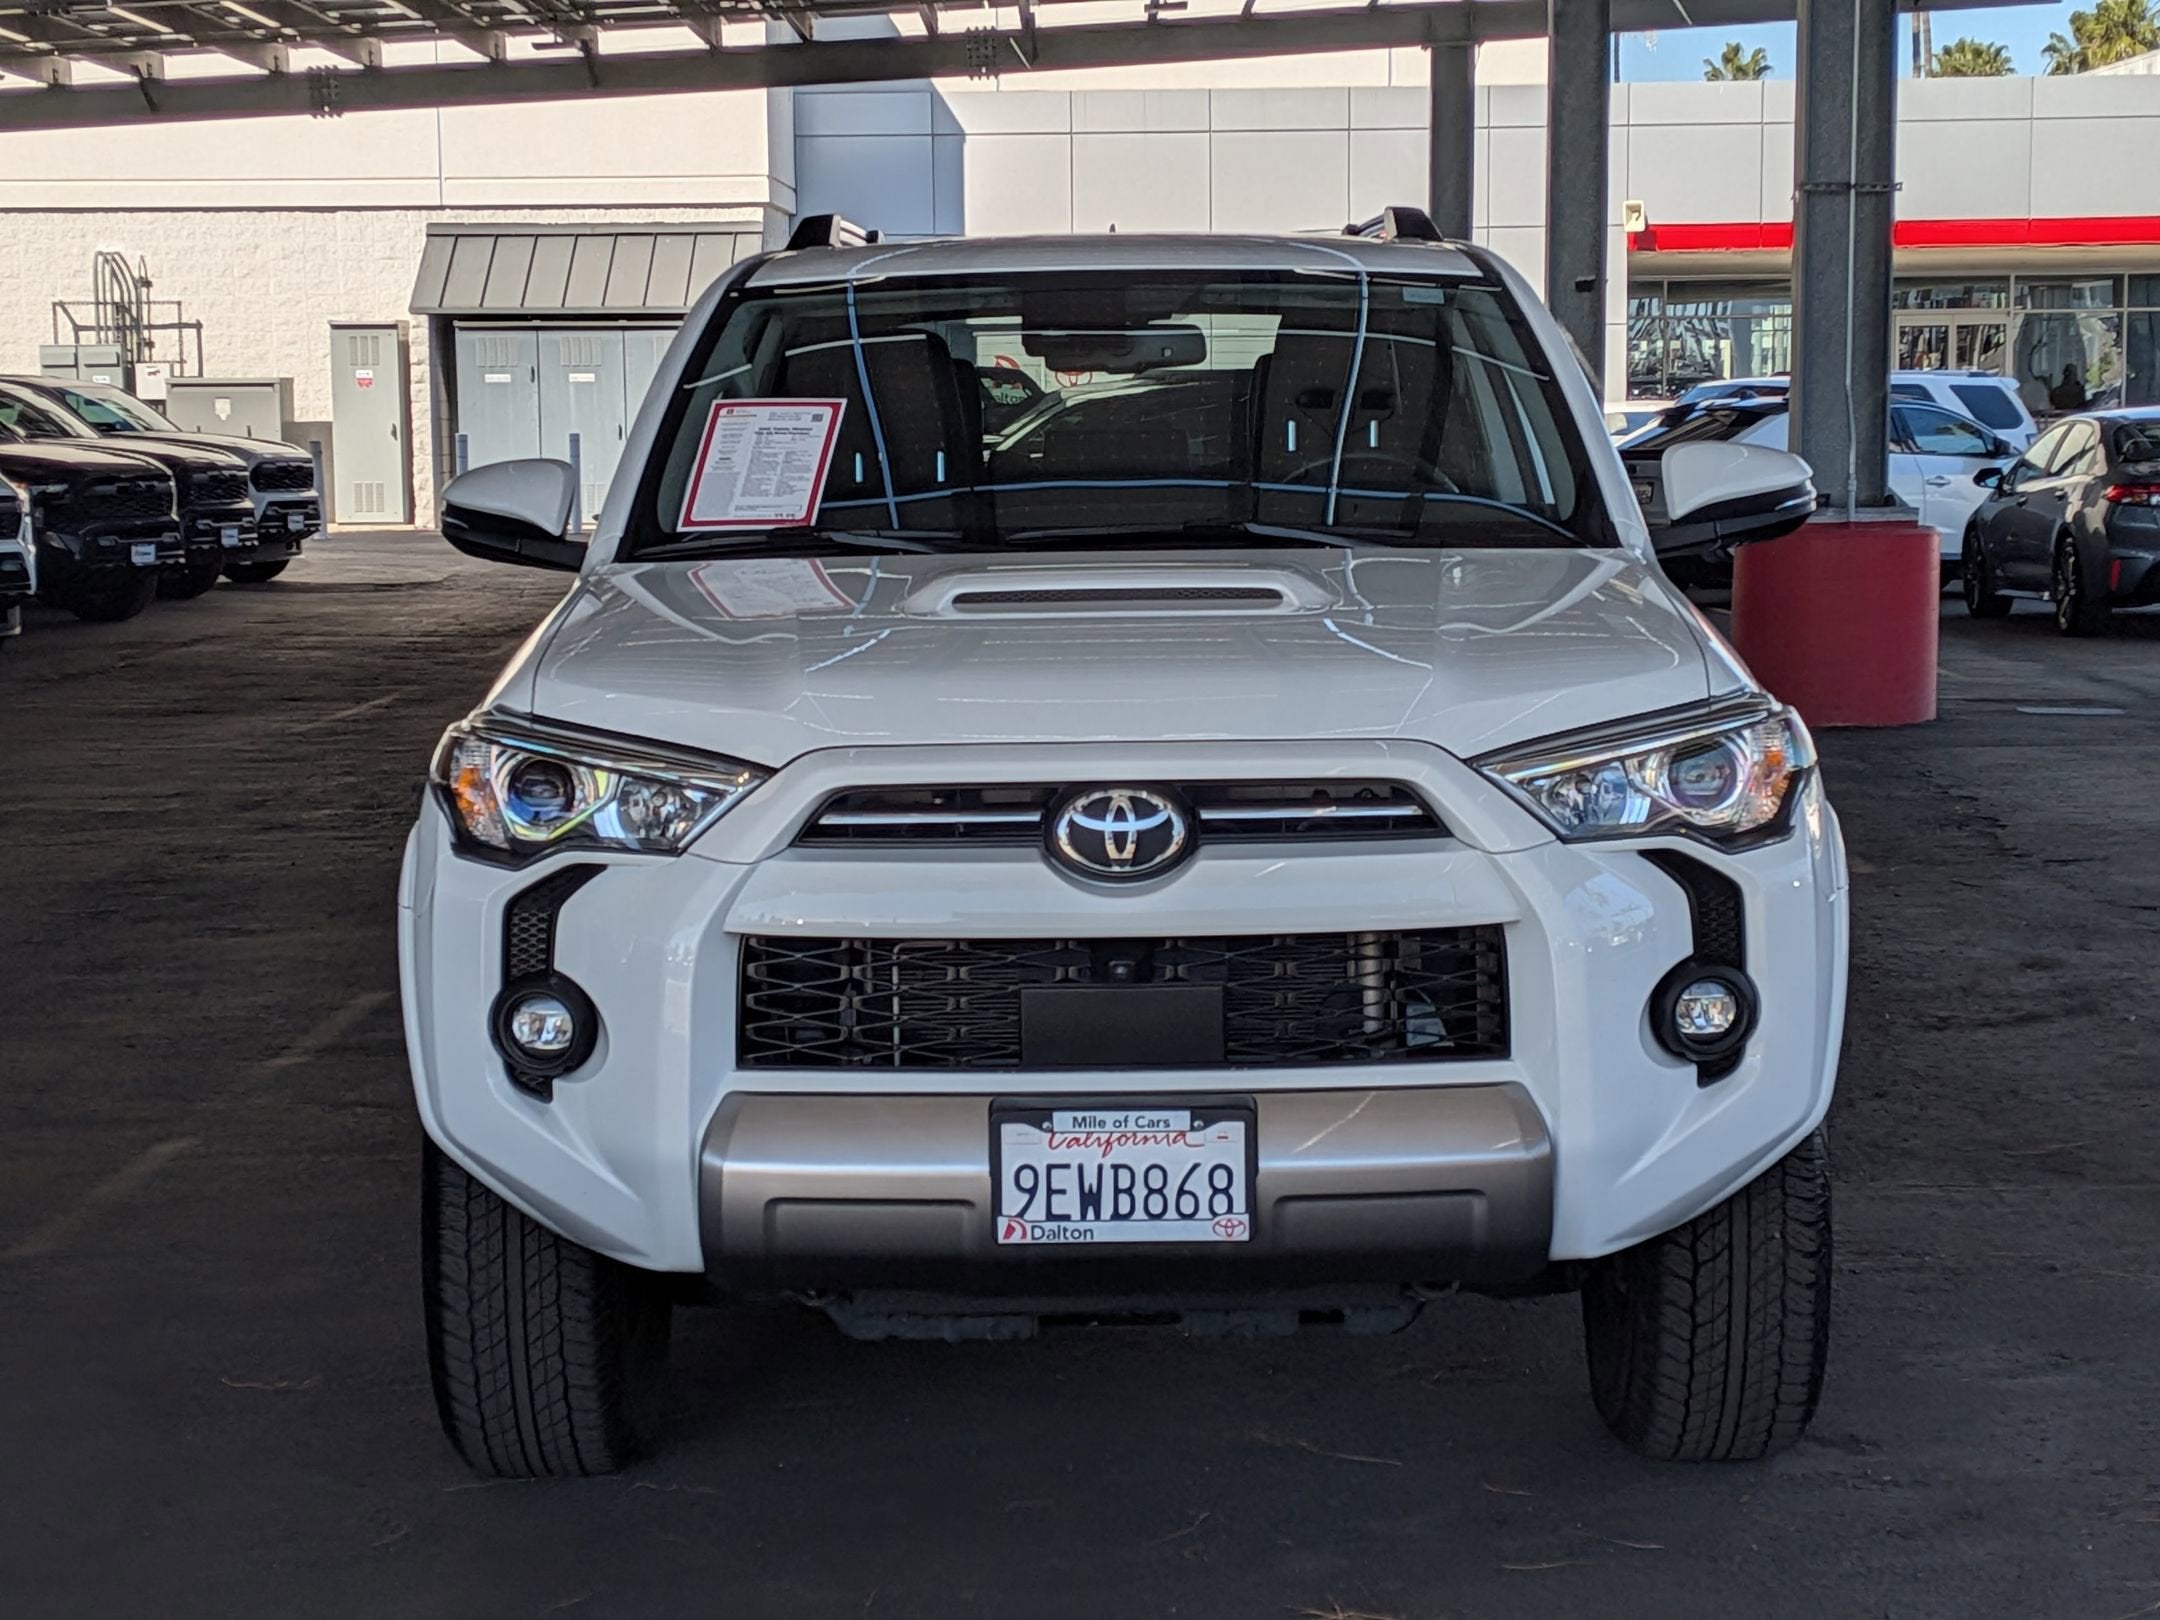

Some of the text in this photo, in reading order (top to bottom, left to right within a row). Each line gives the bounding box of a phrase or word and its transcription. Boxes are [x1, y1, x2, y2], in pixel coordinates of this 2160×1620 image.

[1072, 1115, 1172, 1129] Mile of Cars
[1047, 1131, 1206, 1158] California
[1014, 1163, 1234, 1221] 9EWB868
[1030, 1224, 1095, 1241] Dalton
